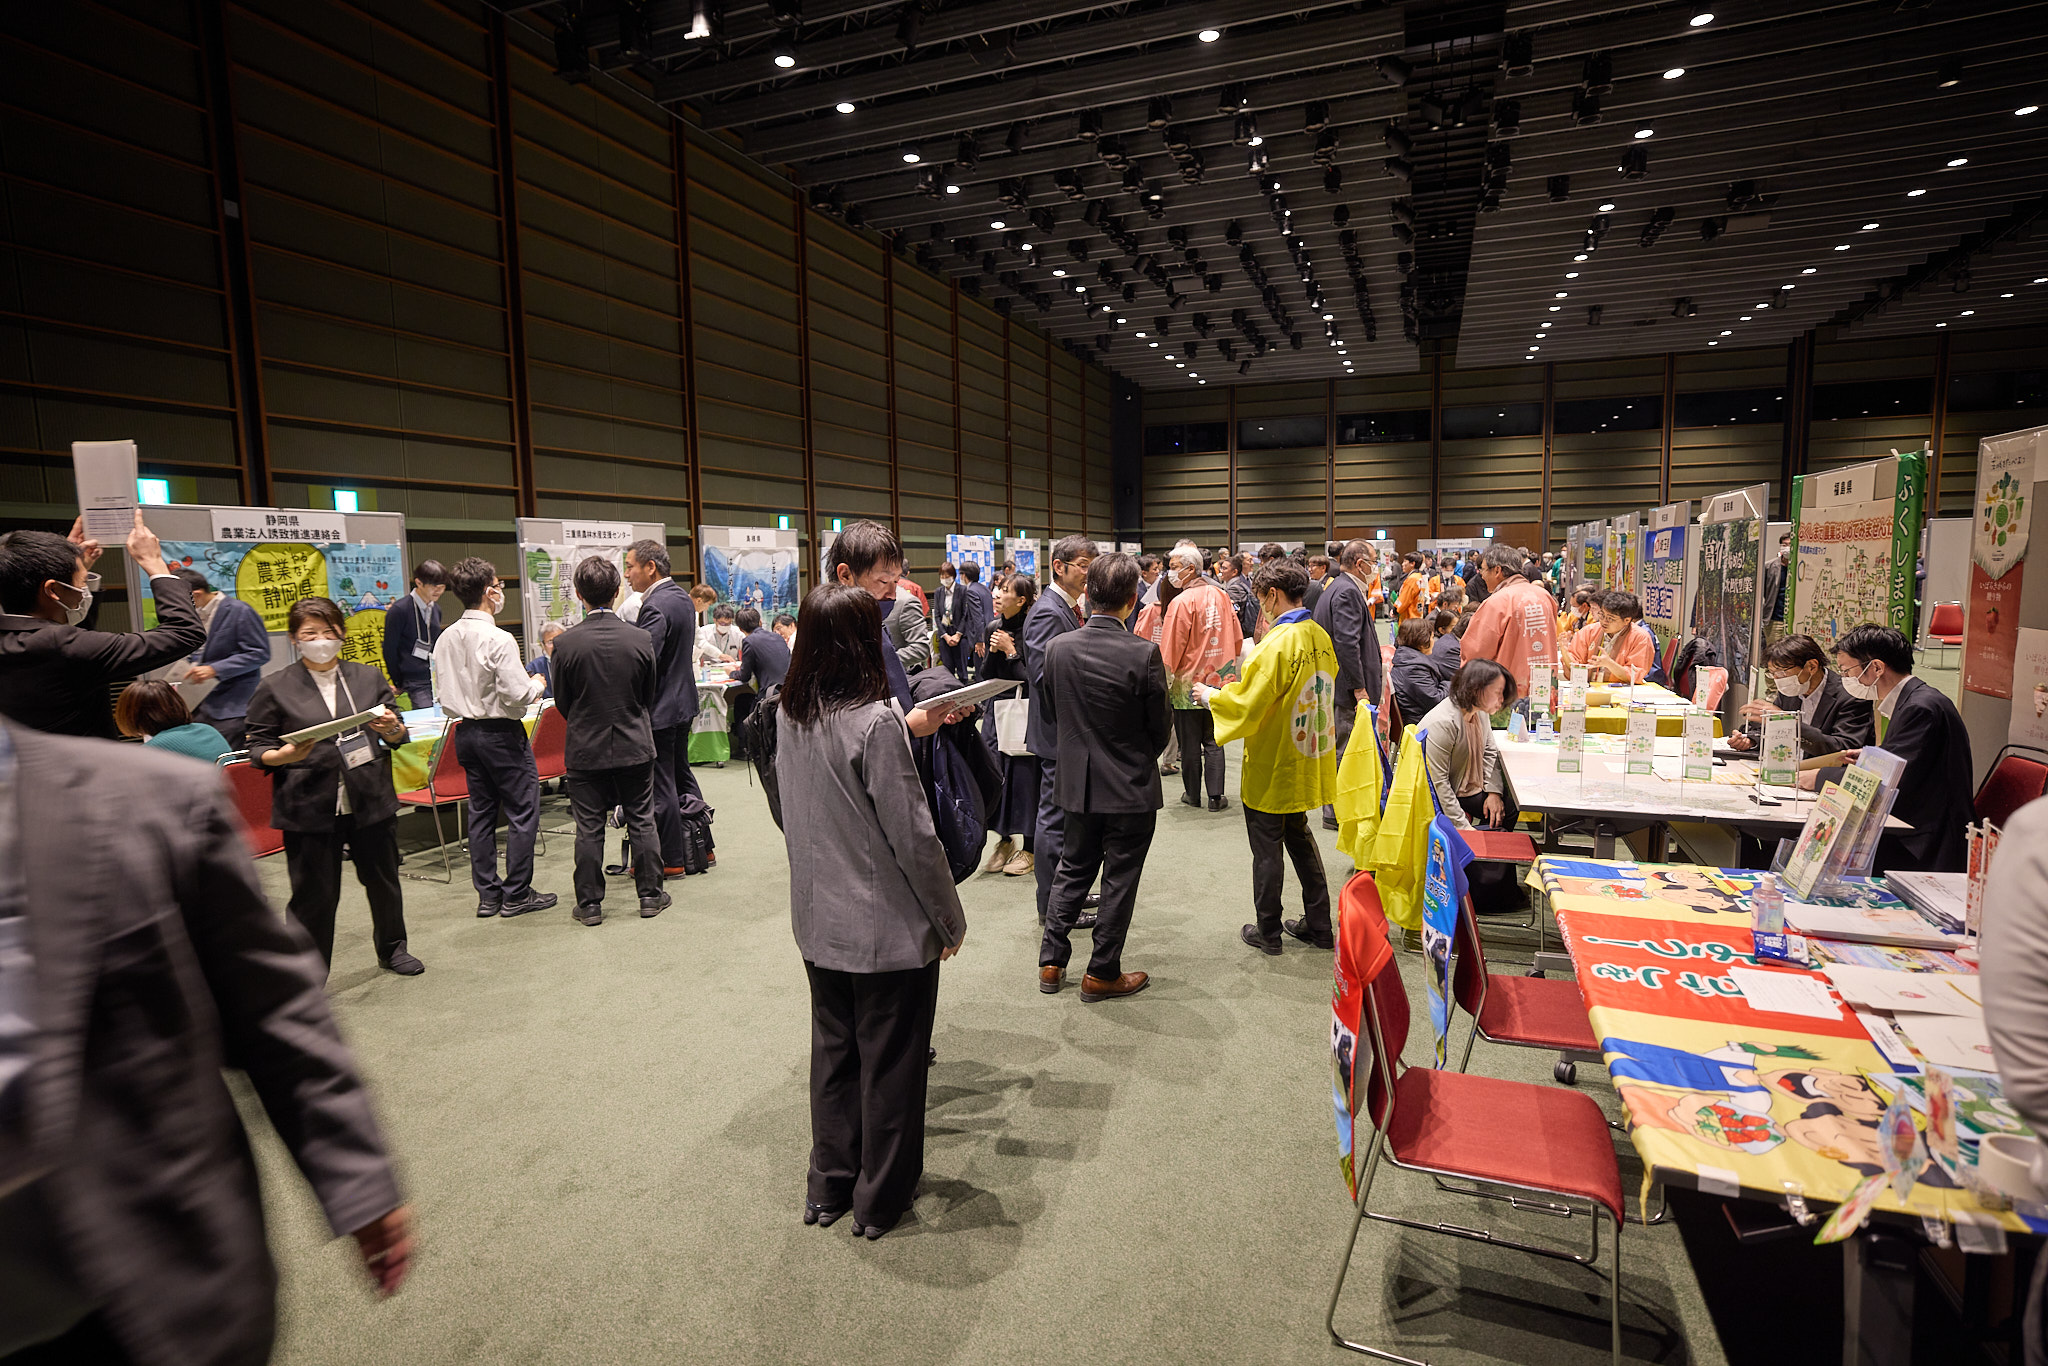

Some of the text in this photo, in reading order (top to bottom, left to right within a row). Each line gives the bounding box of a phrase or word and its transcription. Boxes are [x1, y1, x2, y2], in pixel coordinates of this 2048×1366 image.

[265, 514, 300, 526] 静岡県
[221, 527, 341, 540] 農業法人誘致推進連絡会
[256, 558, 292, 584] 農業
[262, 578, 315, 610] 静岡県
